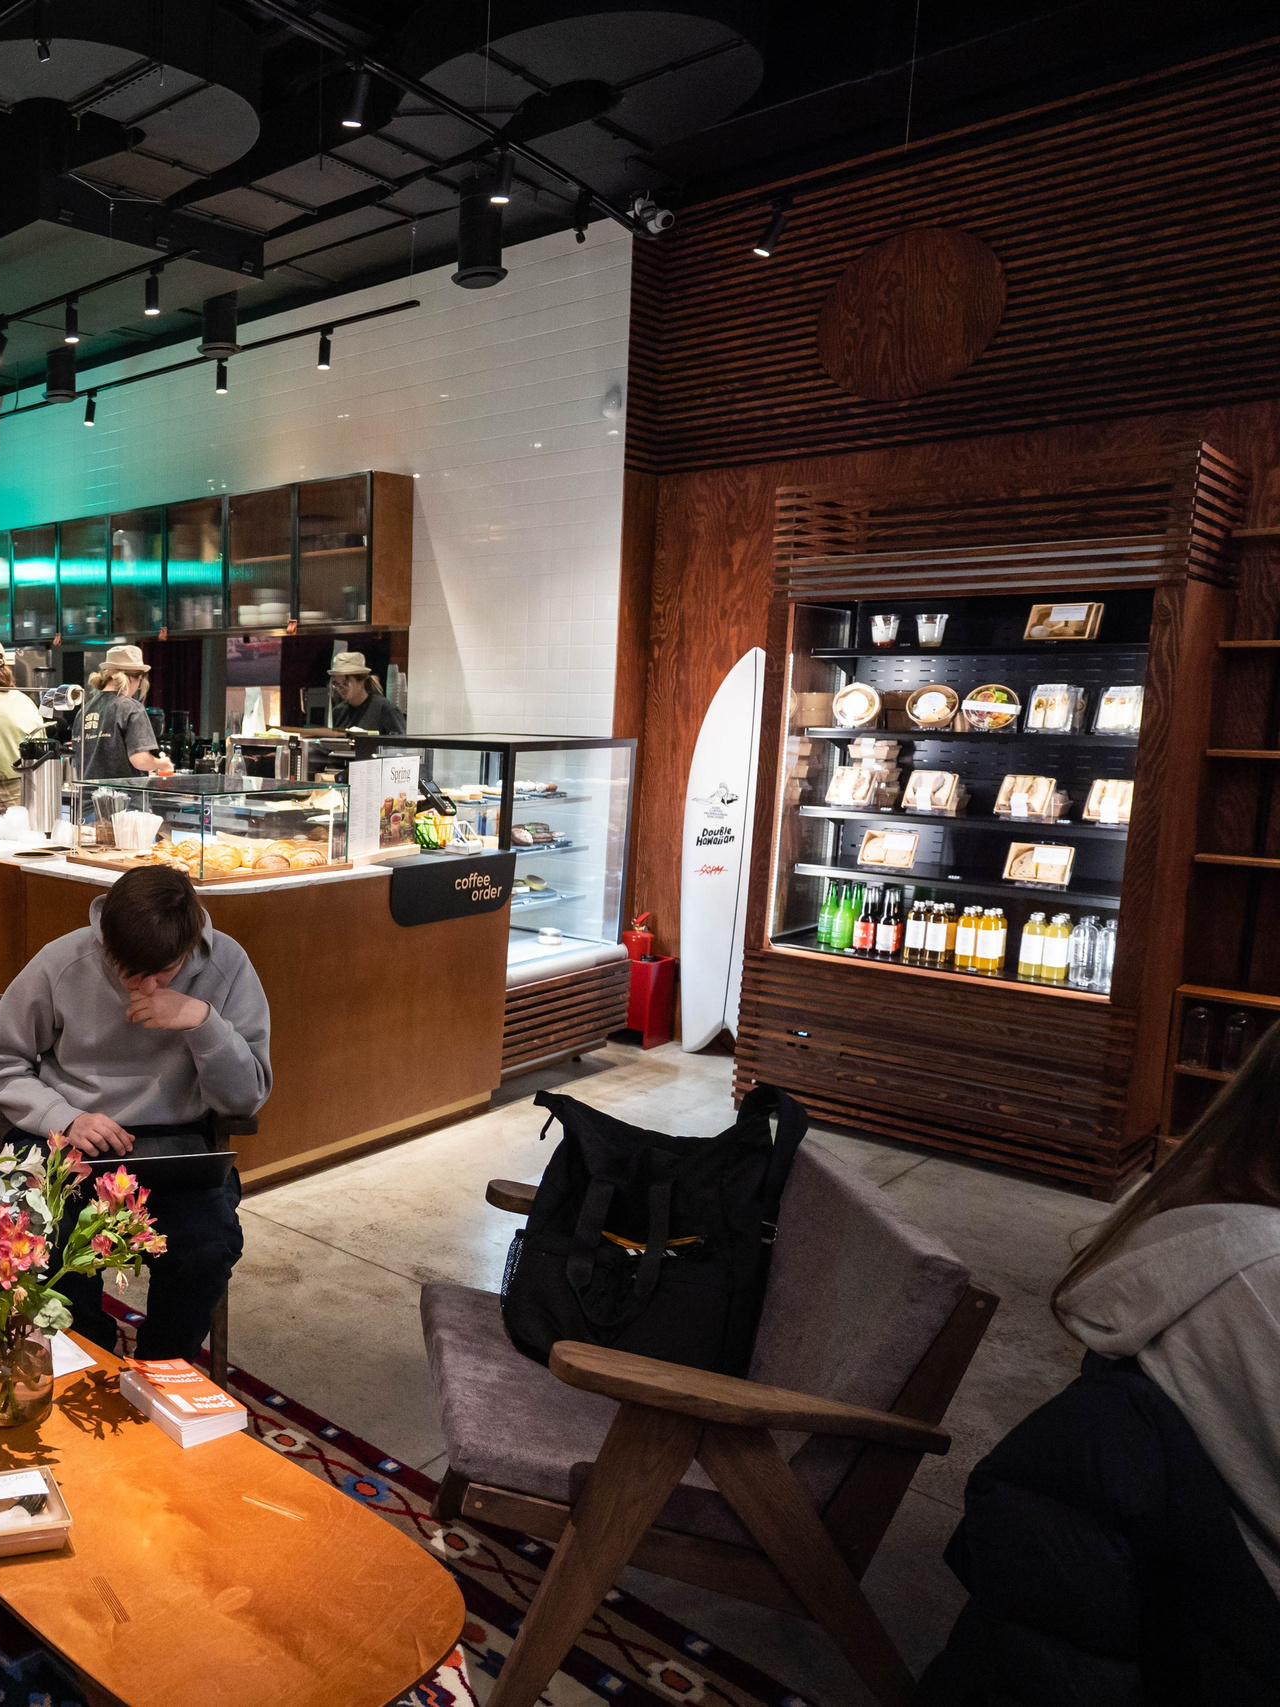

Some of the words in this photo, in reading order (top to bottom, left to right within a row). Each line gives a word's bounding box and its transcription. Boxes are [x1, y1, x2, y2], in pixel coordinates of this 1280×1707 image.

[390, 766, 411, 784] Spring
[454, 872, 491, 890] coffee
[471, 885, 503, 901] order
[192, 1393, 228, 1403] Дойч
[192, 1399, 236, 1409] Дэвид
